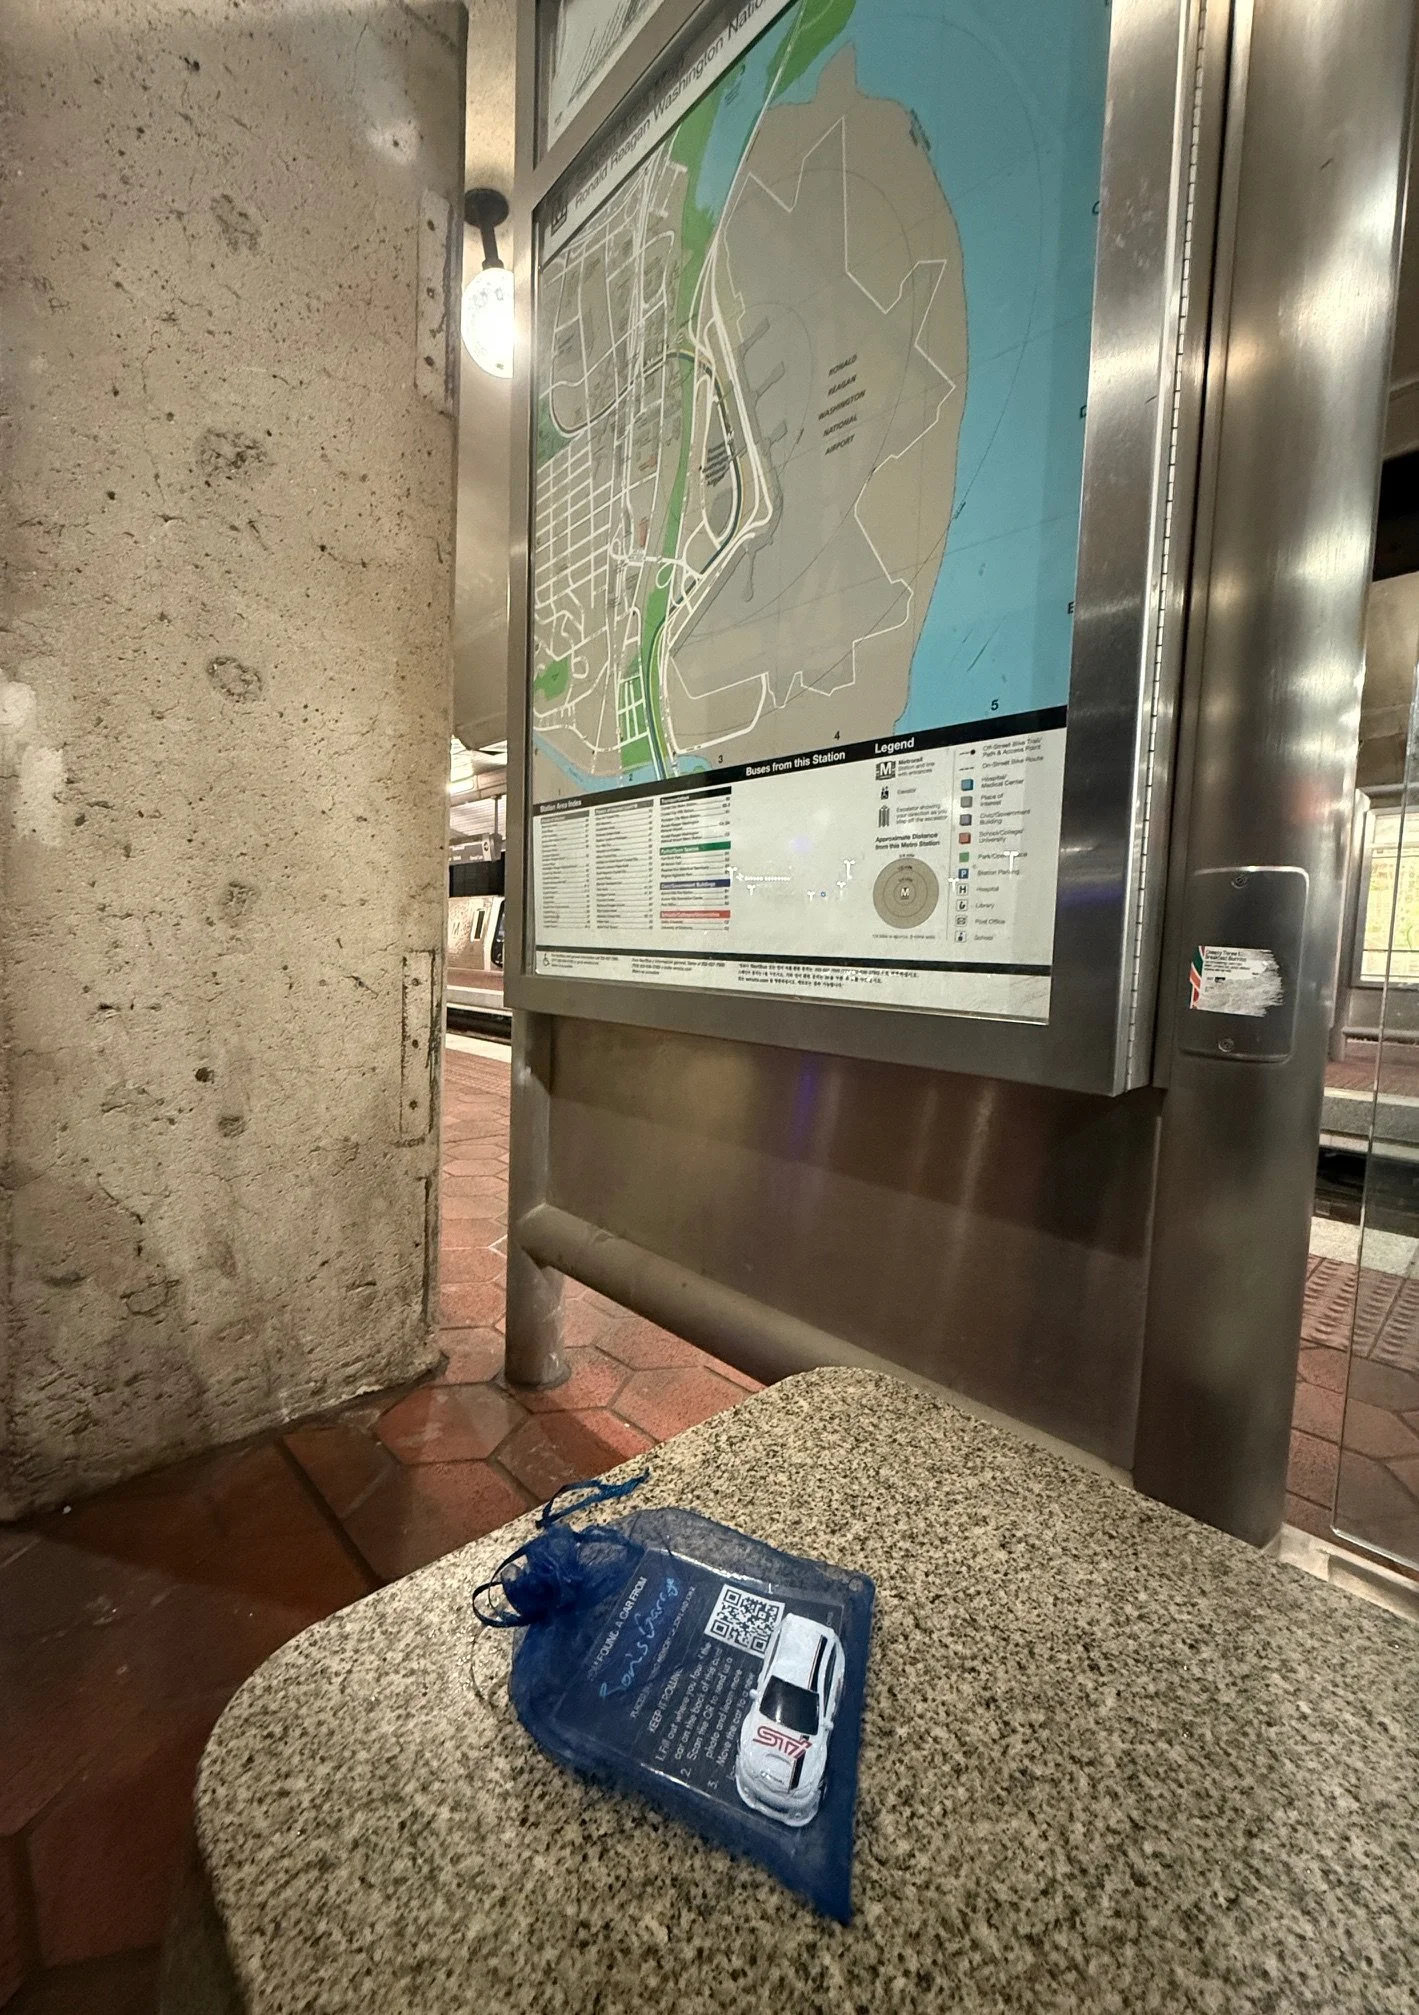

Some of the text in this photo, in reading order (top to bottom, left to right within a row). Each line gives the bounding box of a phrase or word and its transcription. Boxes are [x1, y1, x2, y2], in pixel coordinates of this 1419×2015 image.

[610, 119, 651, 171] Reagan
[653, 37, 724, 123] Washington
[991, 699, 999, 711] 5
[833, 730, 841, 741] 4
[874, 737, 915, 755] Legend
[718, 754, 724, 764] 3
[745, 751, 846, 777] Buses from this Station
[615, 1620, 623, 1629] A
[619, 1600, 635, 1620] CAR
[629, 1576, 648, 1601] FROM
